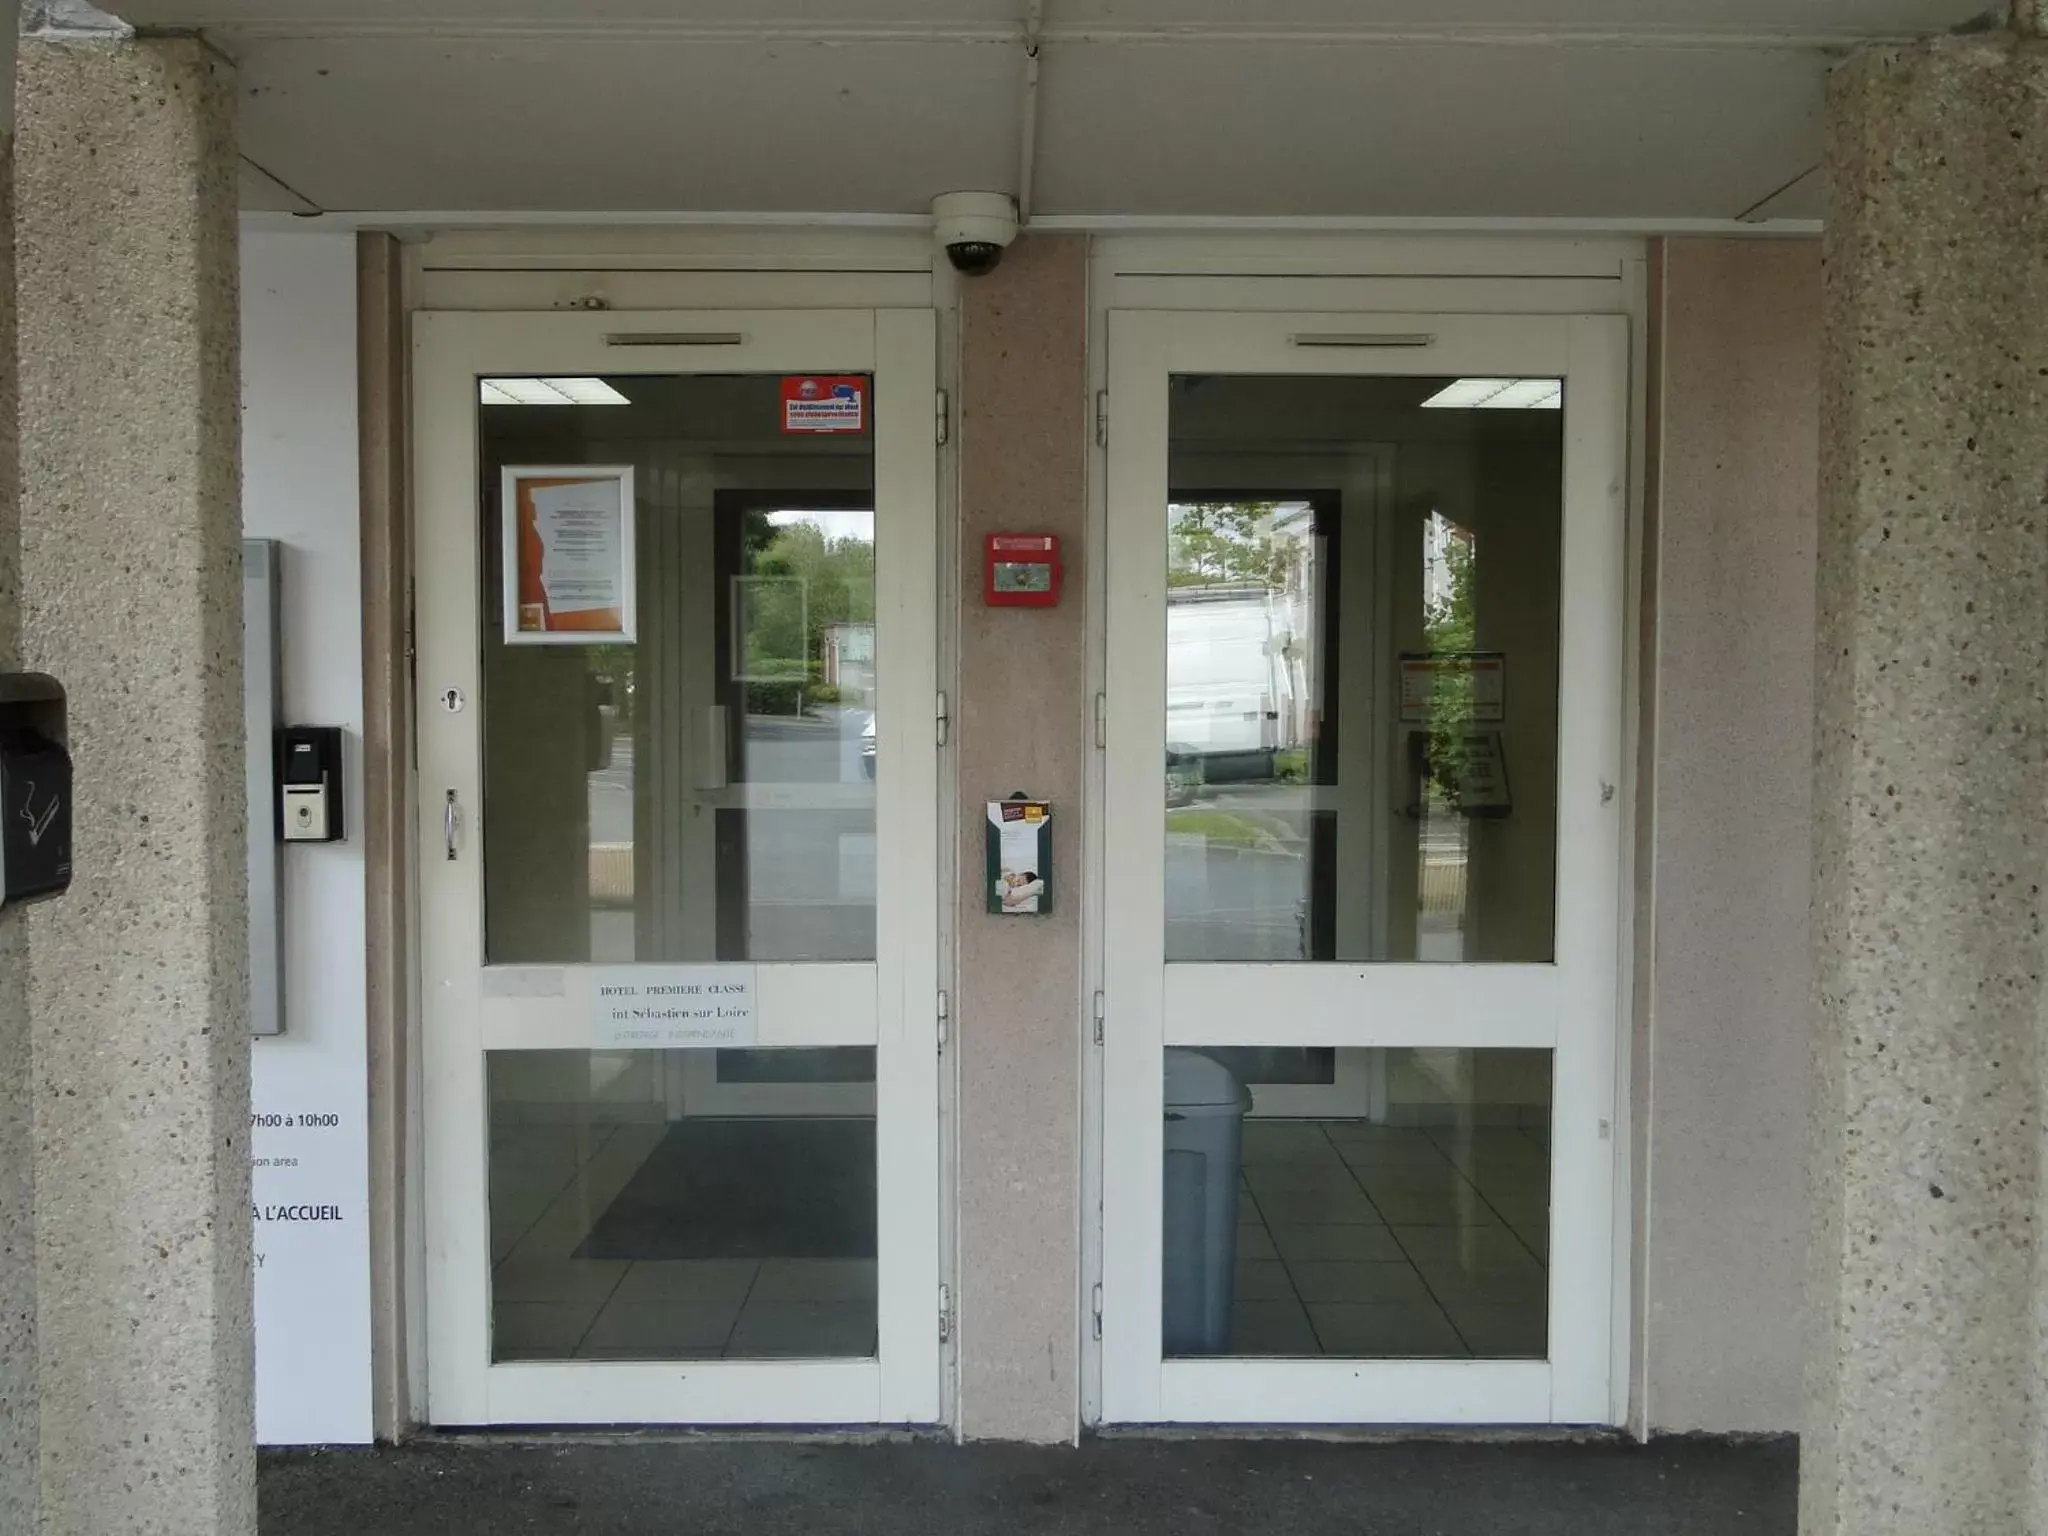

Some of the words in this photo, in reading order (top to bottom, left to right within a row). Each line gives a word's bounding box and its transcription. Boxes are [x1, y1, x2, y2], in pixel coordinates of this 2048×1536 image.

[600, 986, 638, 997] HOTEL
[646, 985, 702, 996] PREMIERE
[708, 983, 748, 994] CLASSE
[693, 1009, 713, 1018] sur
[716, 1006, 749, 1018] Loire
[285, 1114, 294, 1127] à
[299, 1113, 339, 1127] 10h00
[273, 1157, 298, 1167] area
[265, 1205, 343, 1221] L'ACCUEIL
